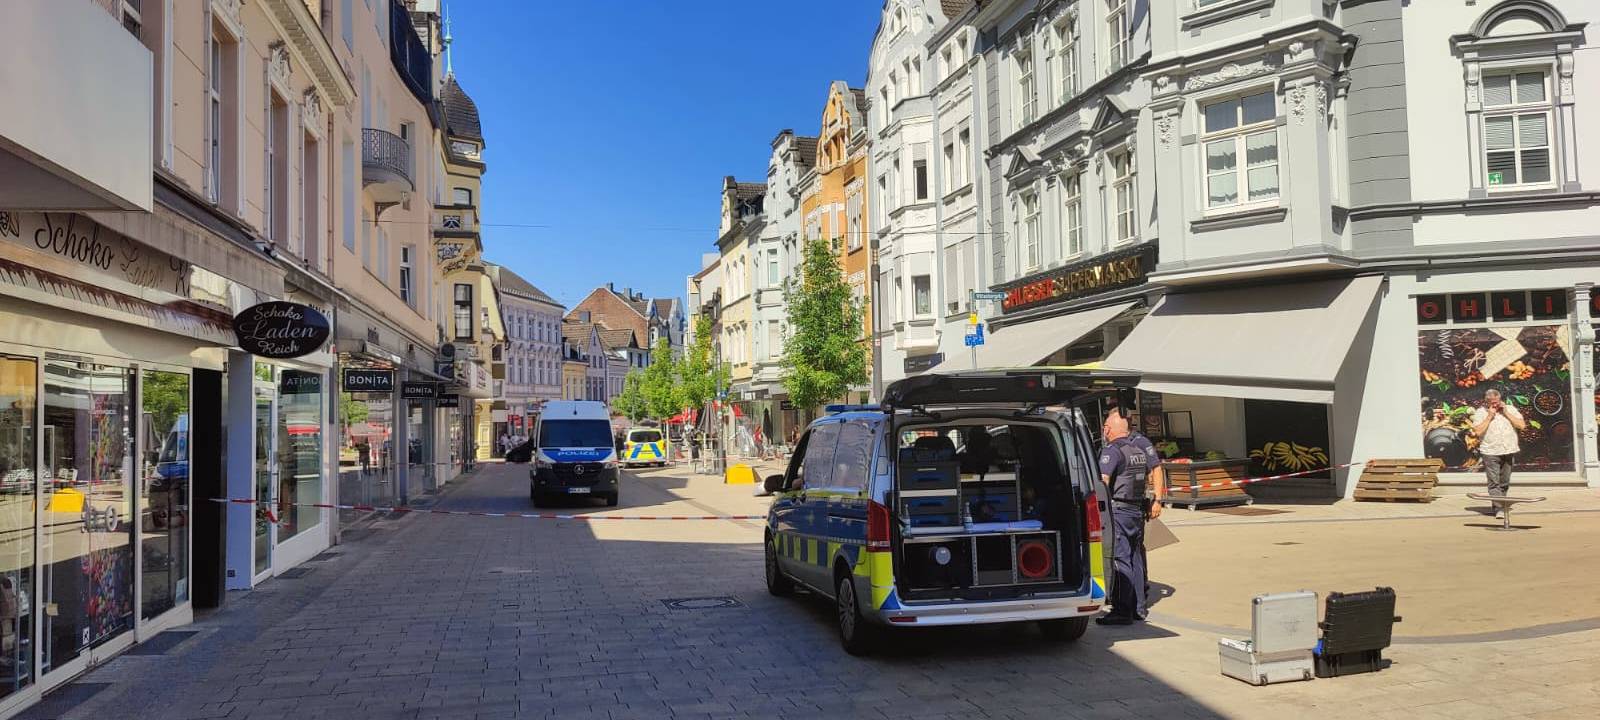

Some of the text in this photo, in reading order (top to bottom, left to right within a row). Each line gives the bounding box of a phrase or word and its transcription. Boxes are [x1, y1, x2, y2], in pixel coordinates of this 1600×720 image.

[254, 305, 303, 320] Schoko
[240, 319, 318, 340] Laden
[258, 340, 300, 355] Reich
[349, 374, 389, 387] BONITA
[405, 386, 433, 396] BONITA
